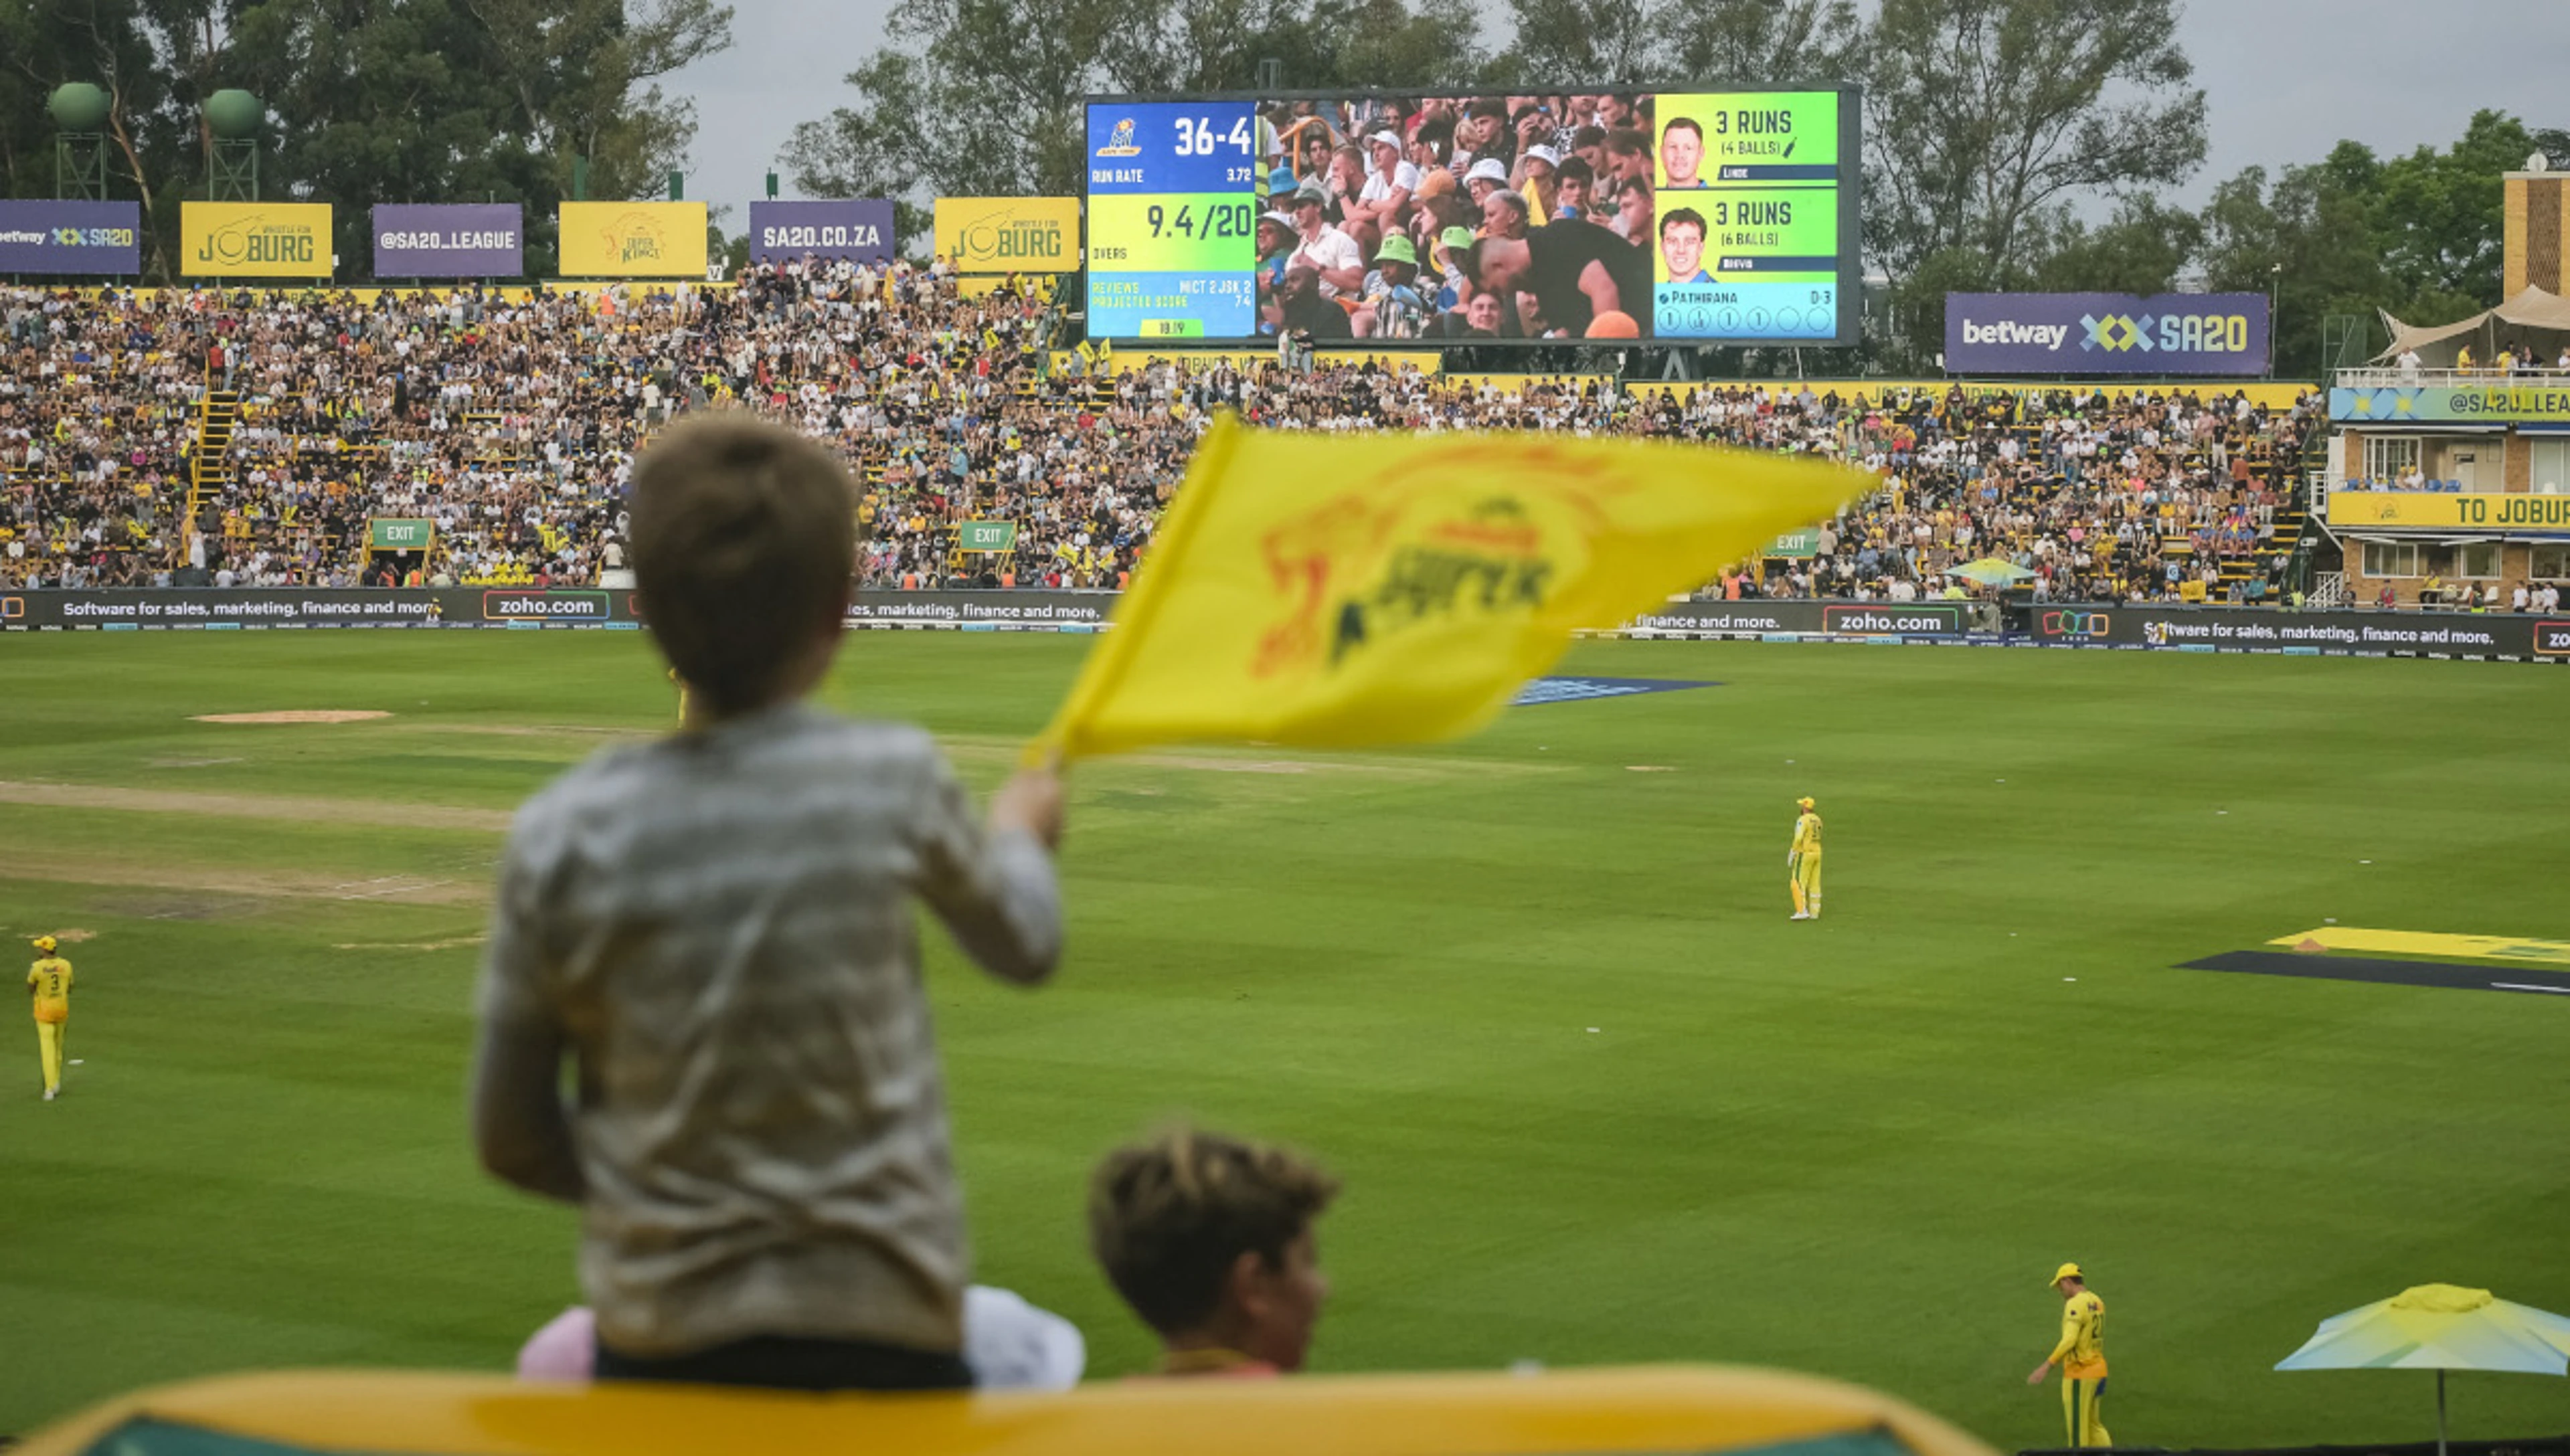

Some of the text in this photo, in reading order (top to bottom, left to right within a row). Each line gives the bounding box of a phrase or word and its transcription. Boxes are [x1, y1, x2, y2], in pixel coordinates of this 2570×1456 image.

[1716, 110, 1792, 134] 3 RUNS
[1175, 117, 1251, 155] 36-4
[1721, 141, 1780, 155] (4 BALLS)
[1092, 169, 1144, 183] RUN RATE
[1227, 168, 1252, 182] 3.72
[1716, 202, 1792, 225] 3 RUNS
[1148, 205, 1251, 240] 9.4/20
[0, 228, 133, 247] etway SA20
[381, 231, 515, 250] @SA20_LEAGUE
[764, 225, 881, 247] SA20.CO.ZA
[1721, 233, 1778, 246] (6 BALLS)
[199, 234, 313, 266] JOBURG
[951, 230, 1061, 262] JOBURG
[1094, 248, 1127, 260] OVERS
[1244, 280, 1252, 294] 2
[1962, 314, 2247, 353] betway SA20
[2456, 498, 2486, 524] TO
[387, 526, 414, 541] EXIT
[975, 528, 1001, 543] EXIT
[1777, 535, 1806, 550] EXIT
[64, 601, 438, 617] Software for sales, marketing, finance and mor
[499, 598, 594, 614] zoho.com
[841, 602, 1100, 619] les, marketing, finance and more.
[1636, 614, 1780, 628] finance and more.
[1841, 612, 1941, 630] zoho.com
[2213, 622, 2234, 636] for
[2236, 624, 2278, 640] sales,
[2281, 625, 2359, 643] marketing,
[2363, 626, 2417, 642] finance
[2420, 627, 2449, 643] and
[2452, 630, 2494, 645] more.
[50, 974, 60, 991] 3
